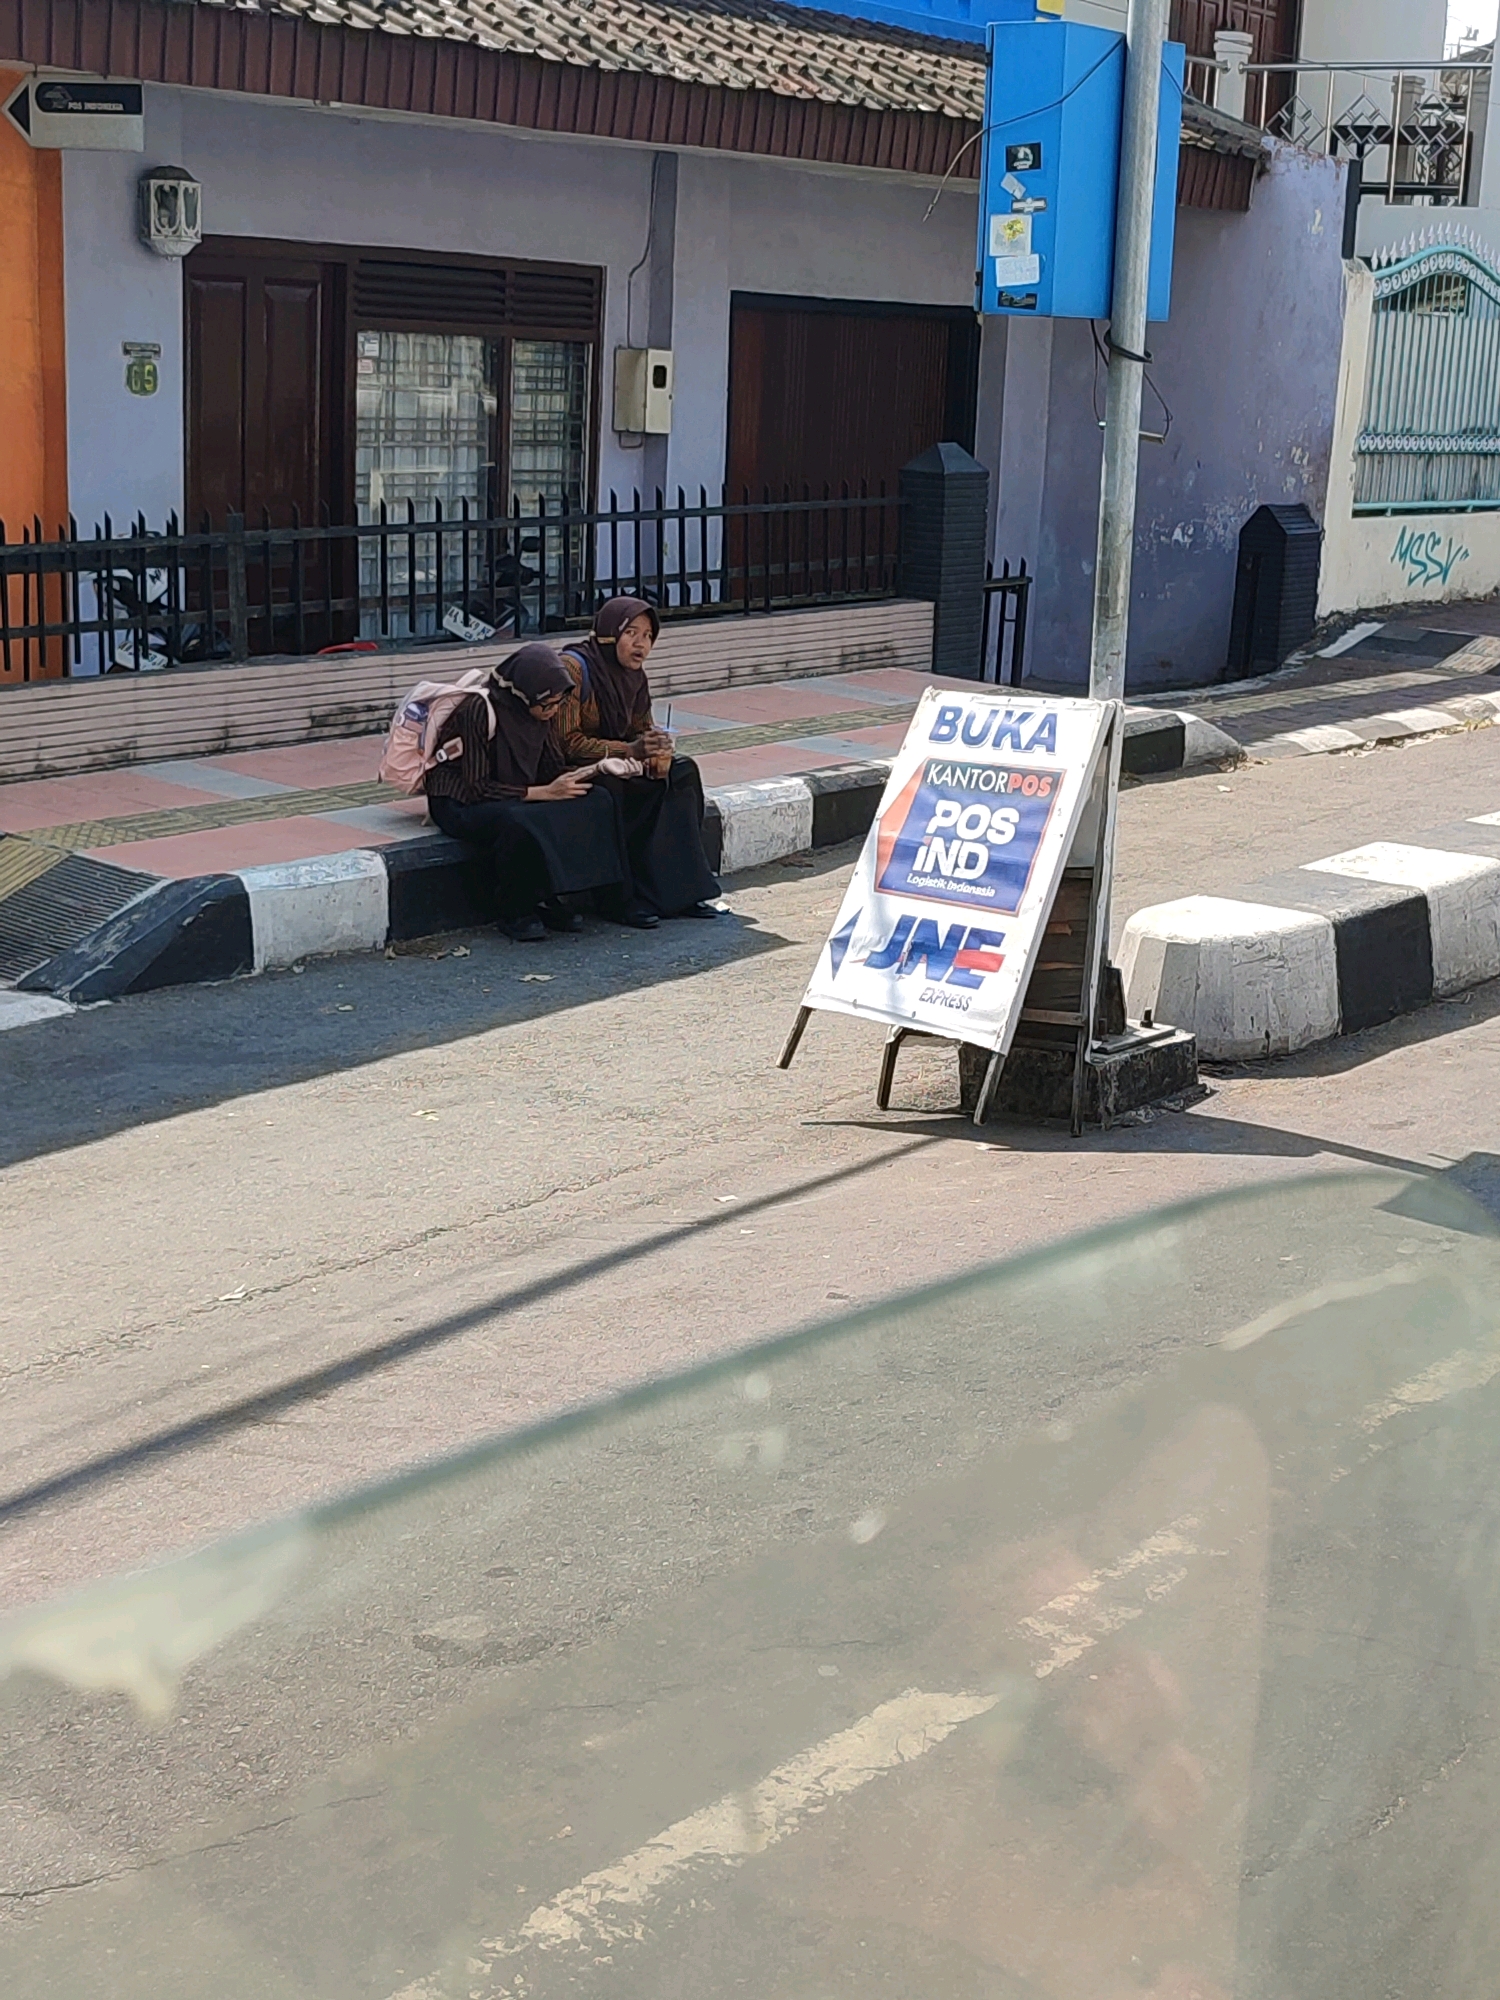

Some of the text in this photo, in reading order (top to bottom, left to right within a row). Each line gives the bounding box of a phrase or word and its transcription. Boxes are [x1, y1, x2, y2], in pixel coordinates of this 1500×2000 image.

[928, 705, 1058, 755] BUKA
[925, 799, 1020, 845] POS
[906, 873, 946, 888] Logistik
[863, 914, 1006, 990] JNE
[919, 987, 972, 1011] EXPRESS
